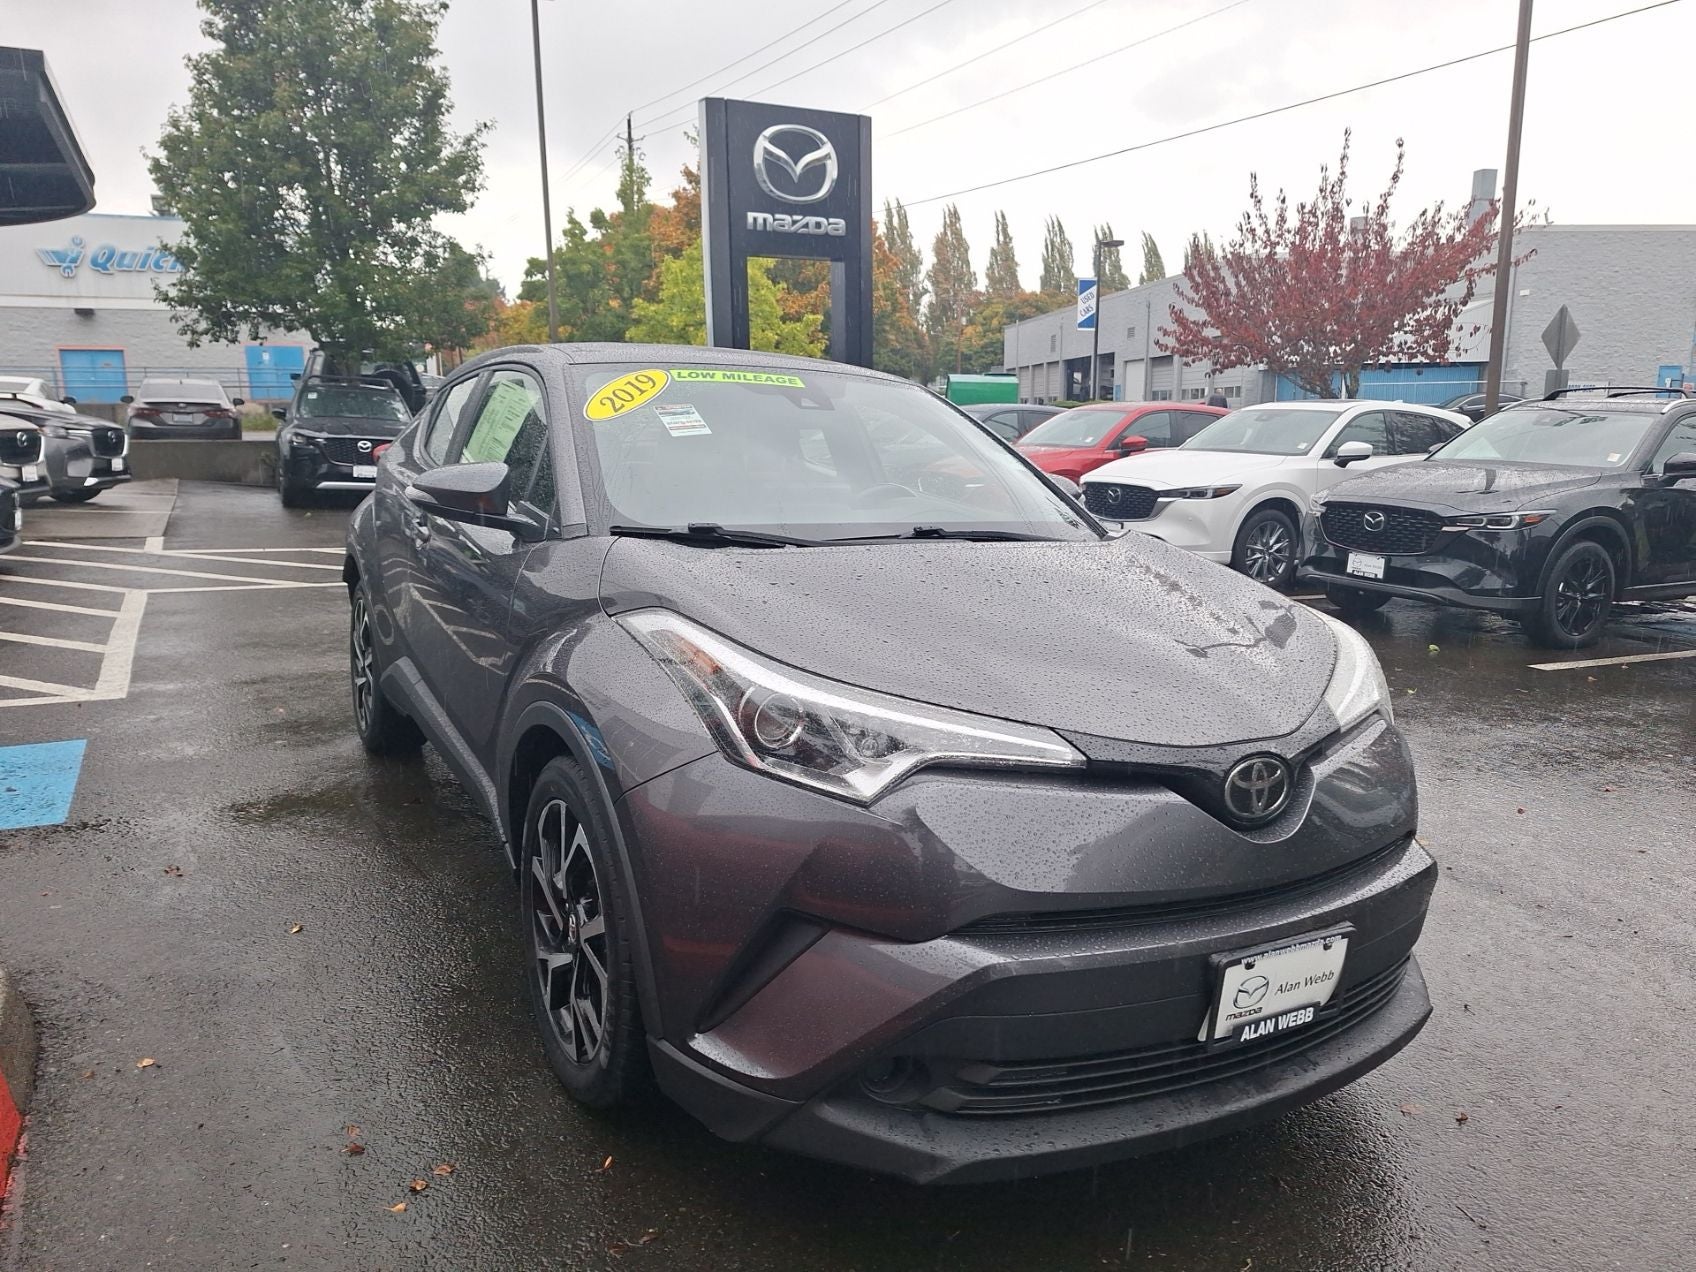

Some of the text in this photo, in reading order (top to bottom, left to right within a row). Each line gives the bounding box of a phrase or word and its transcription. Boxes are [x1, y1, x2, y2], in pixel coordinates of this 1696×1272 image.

[1080, 291, 1095, 305] USED
[1079, 304, 1094, 318] CARS
[676, 370, 799, 386] LOW MILEAGE
[599, 373, 657, 414] 2019
[1274, 969, 1335, 996] Alan Webb
[1240, 1006, 1315, 1042] ALAN WEBB
